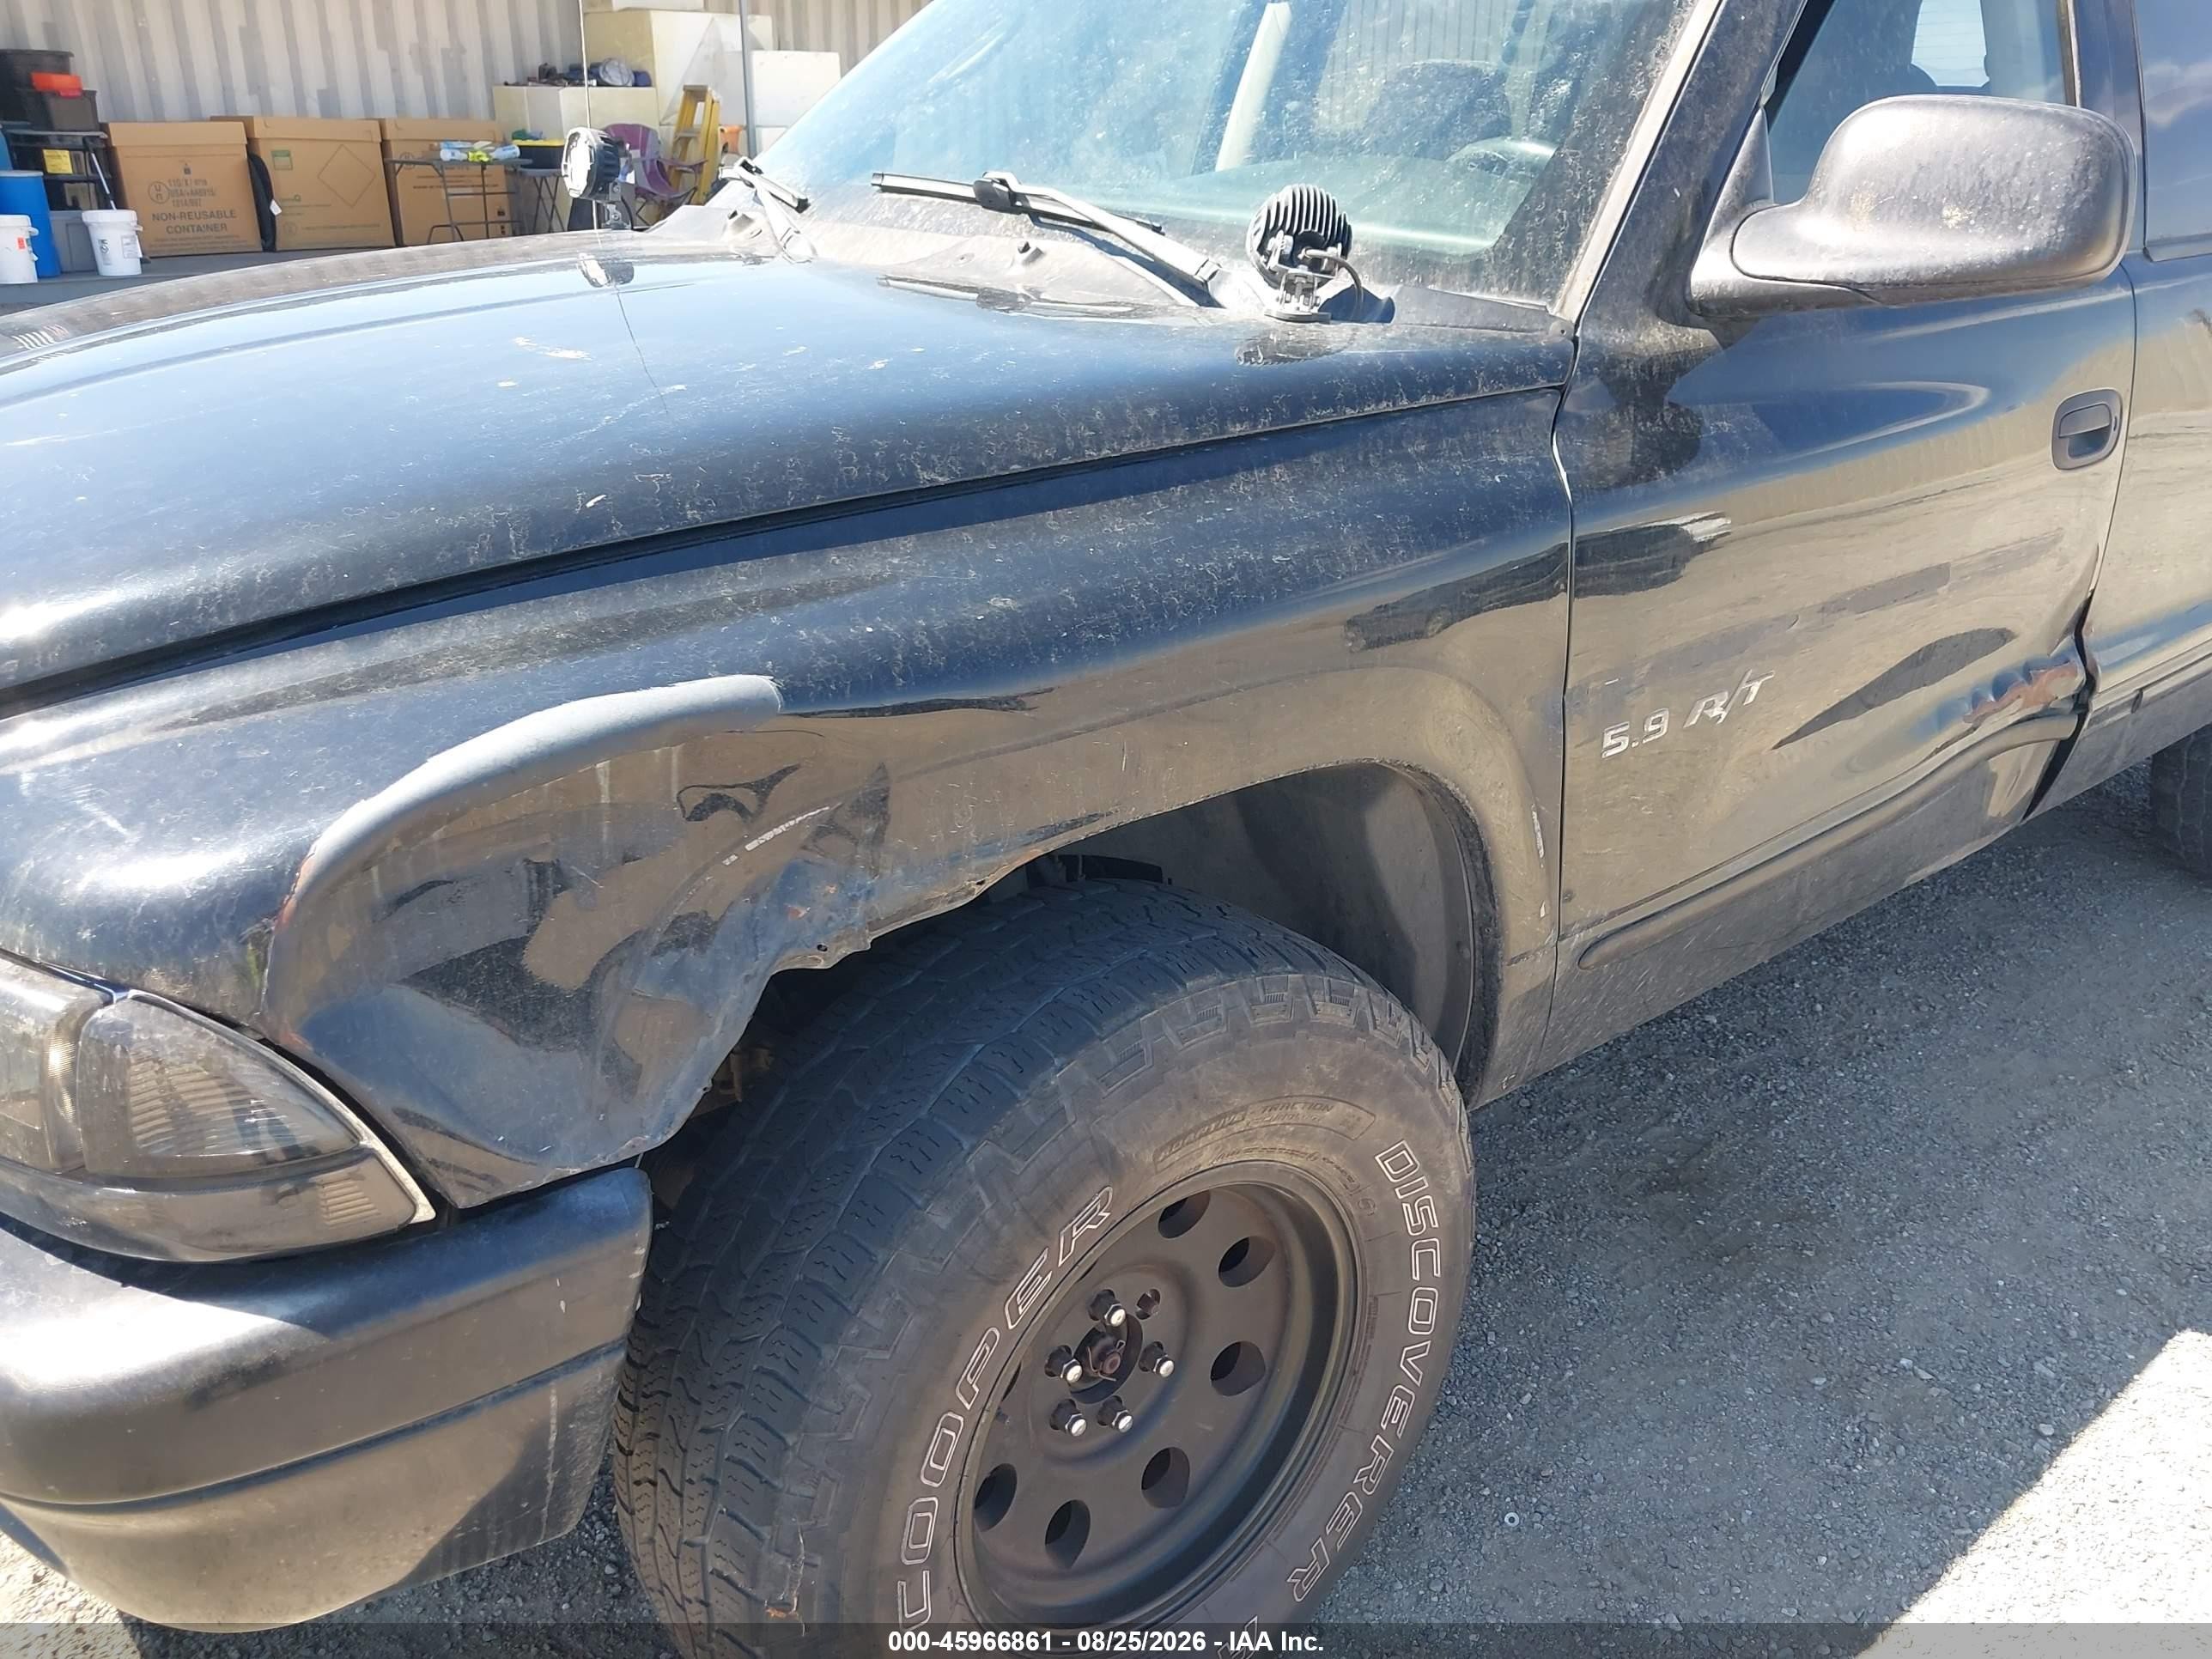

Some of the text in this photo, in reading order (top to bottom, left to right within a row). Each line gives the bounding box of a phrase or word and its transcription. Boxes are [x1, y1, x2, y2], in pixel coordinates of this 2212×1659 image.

[152, 210, 237, 222] NON-REUSABLE
[166, 223, 228, 234] CONTAINER
[1601, 669, 1775, 759] 5.9 R/T
[897, 1185, 1115, 1631] COOPER
[1286, 1139, 1442, 1605] DISCOVERER
